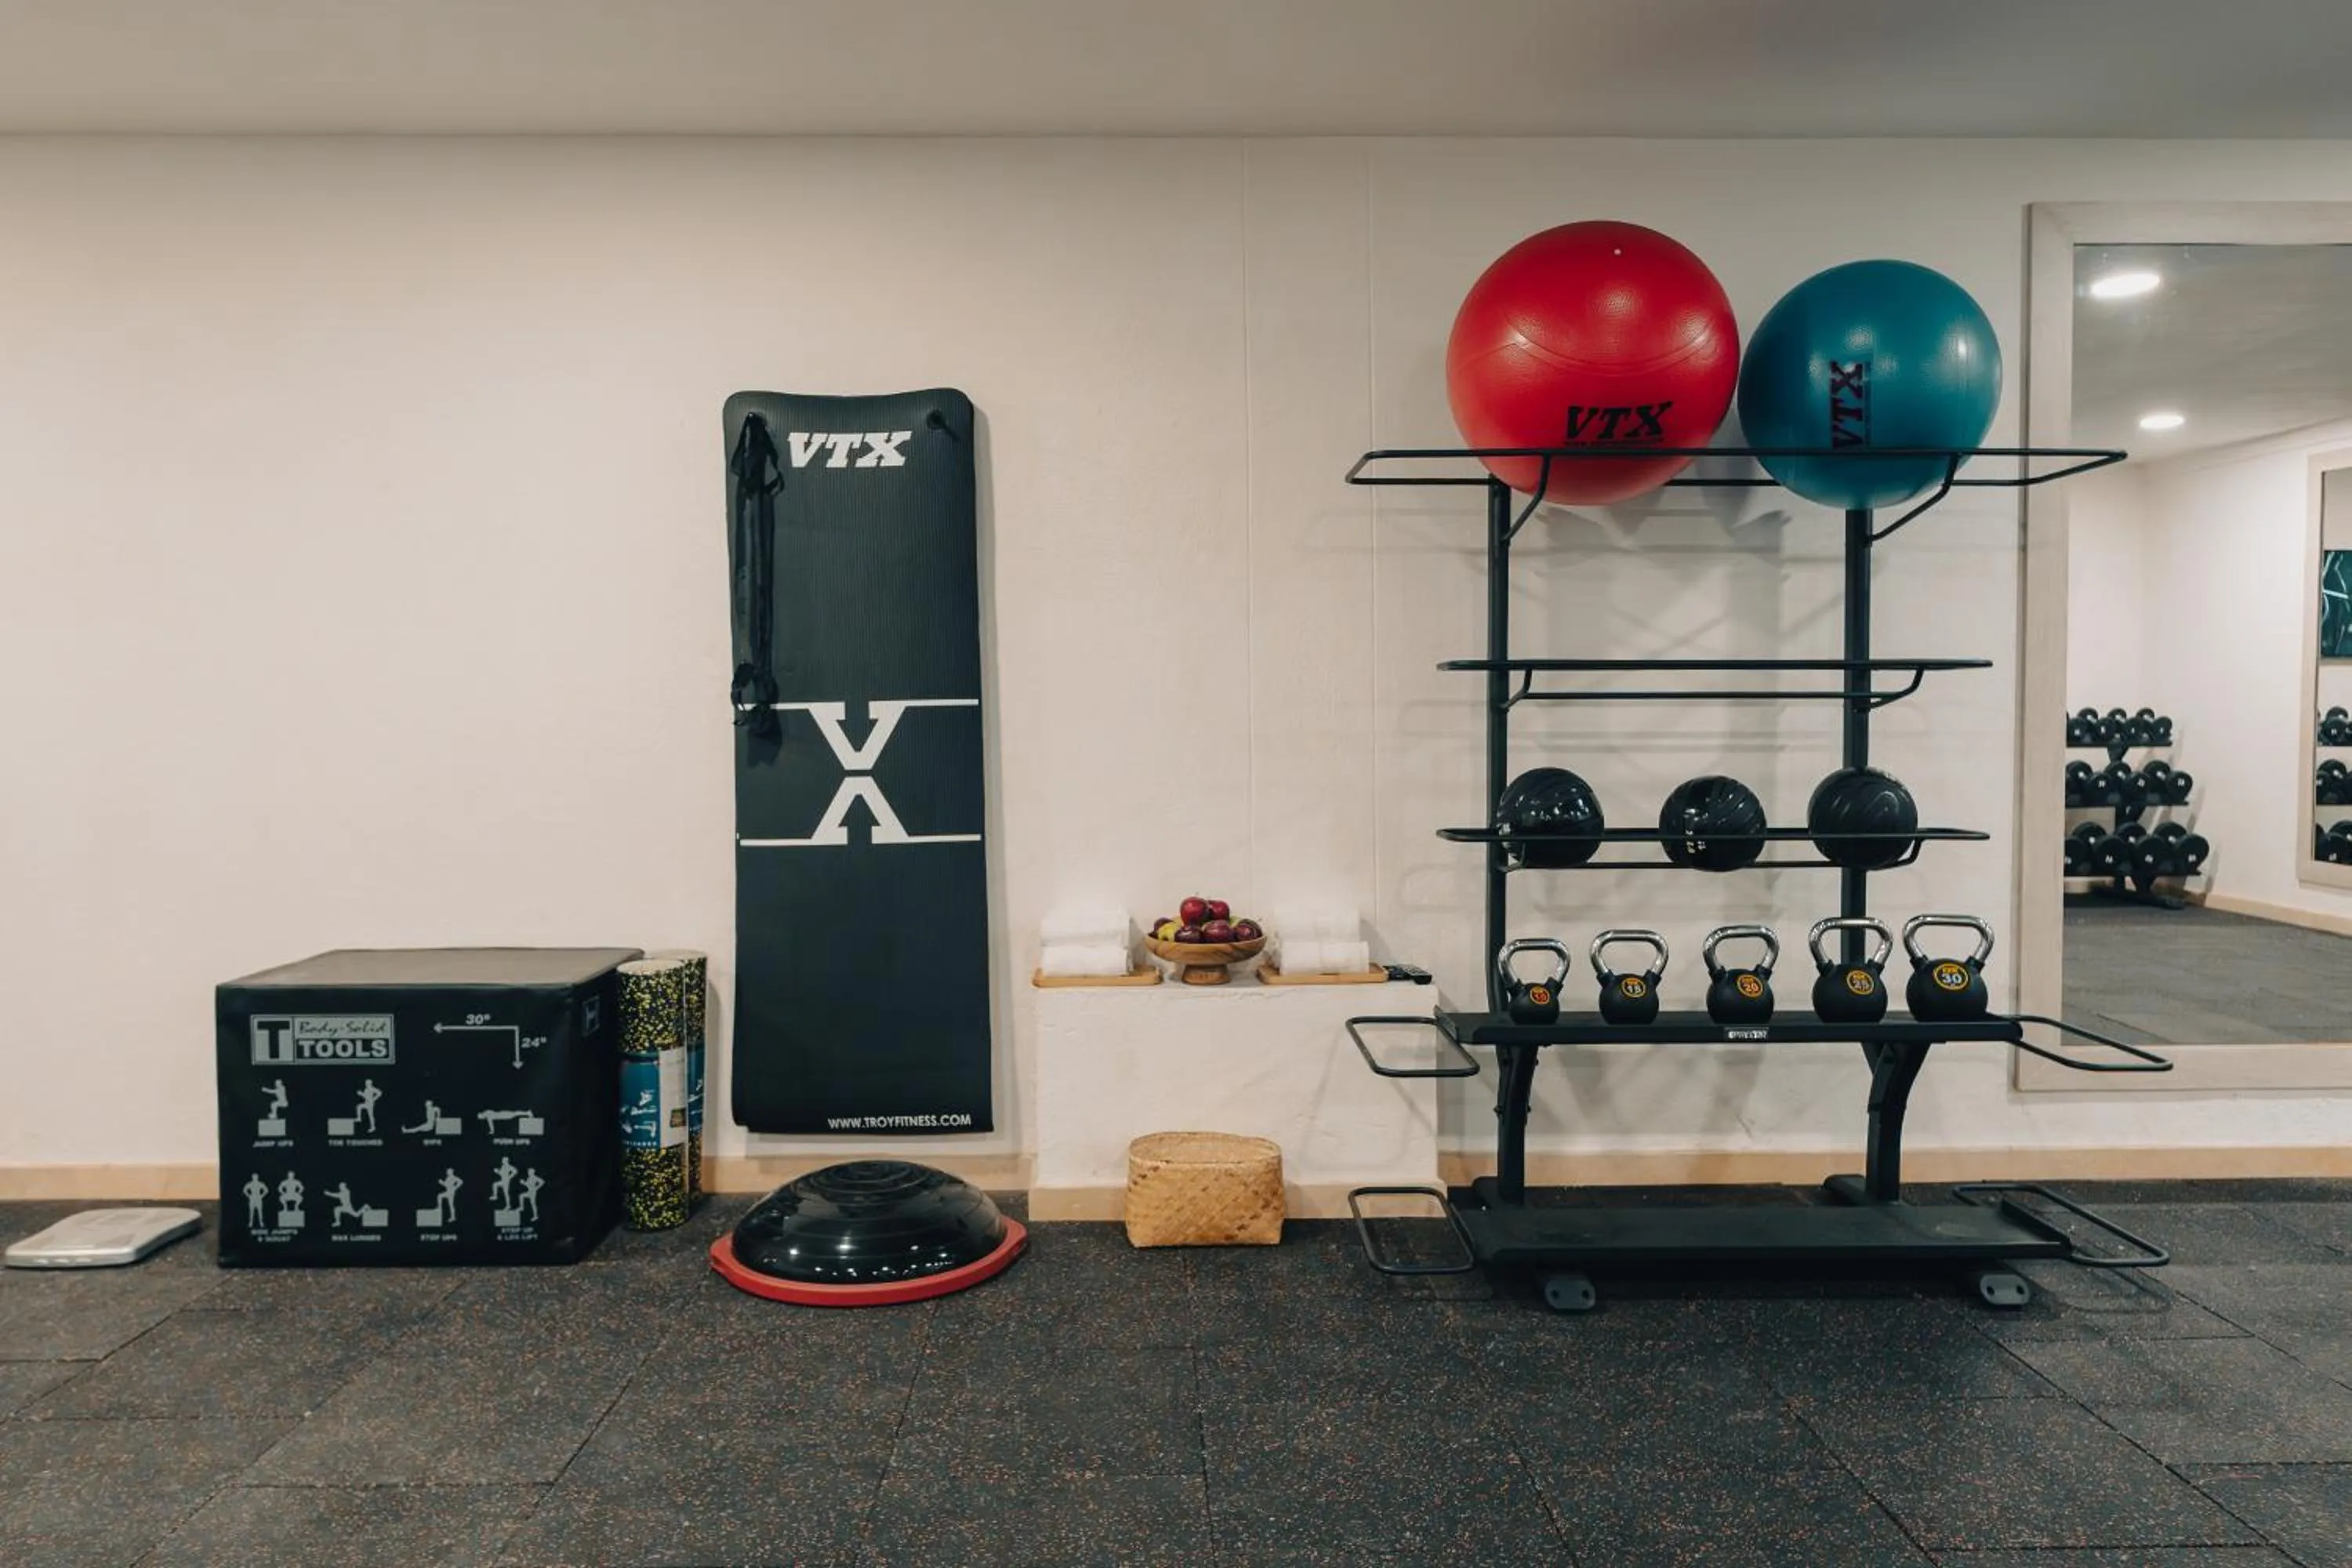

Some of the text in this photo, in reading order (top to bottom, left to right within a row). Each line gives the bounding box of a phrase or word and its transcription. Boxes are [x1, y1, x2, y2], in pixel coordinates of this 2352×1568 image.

[1830, 361, 1864, 449] VTX
[1567, 401, 1674, 439] VTX
[787, 430, 913, 468] VTX
[1941, 973, 1962, 984] 30
[465, 1014, 491, 1025] 30"
[257, 1021, 290, 1059] T
[298, 1040, 387, 1058] TOOLS
[521, 1036, 546, 1048] 24"
[827, 1113, 972, 1130] WWW.TROYFITNESS.COM
